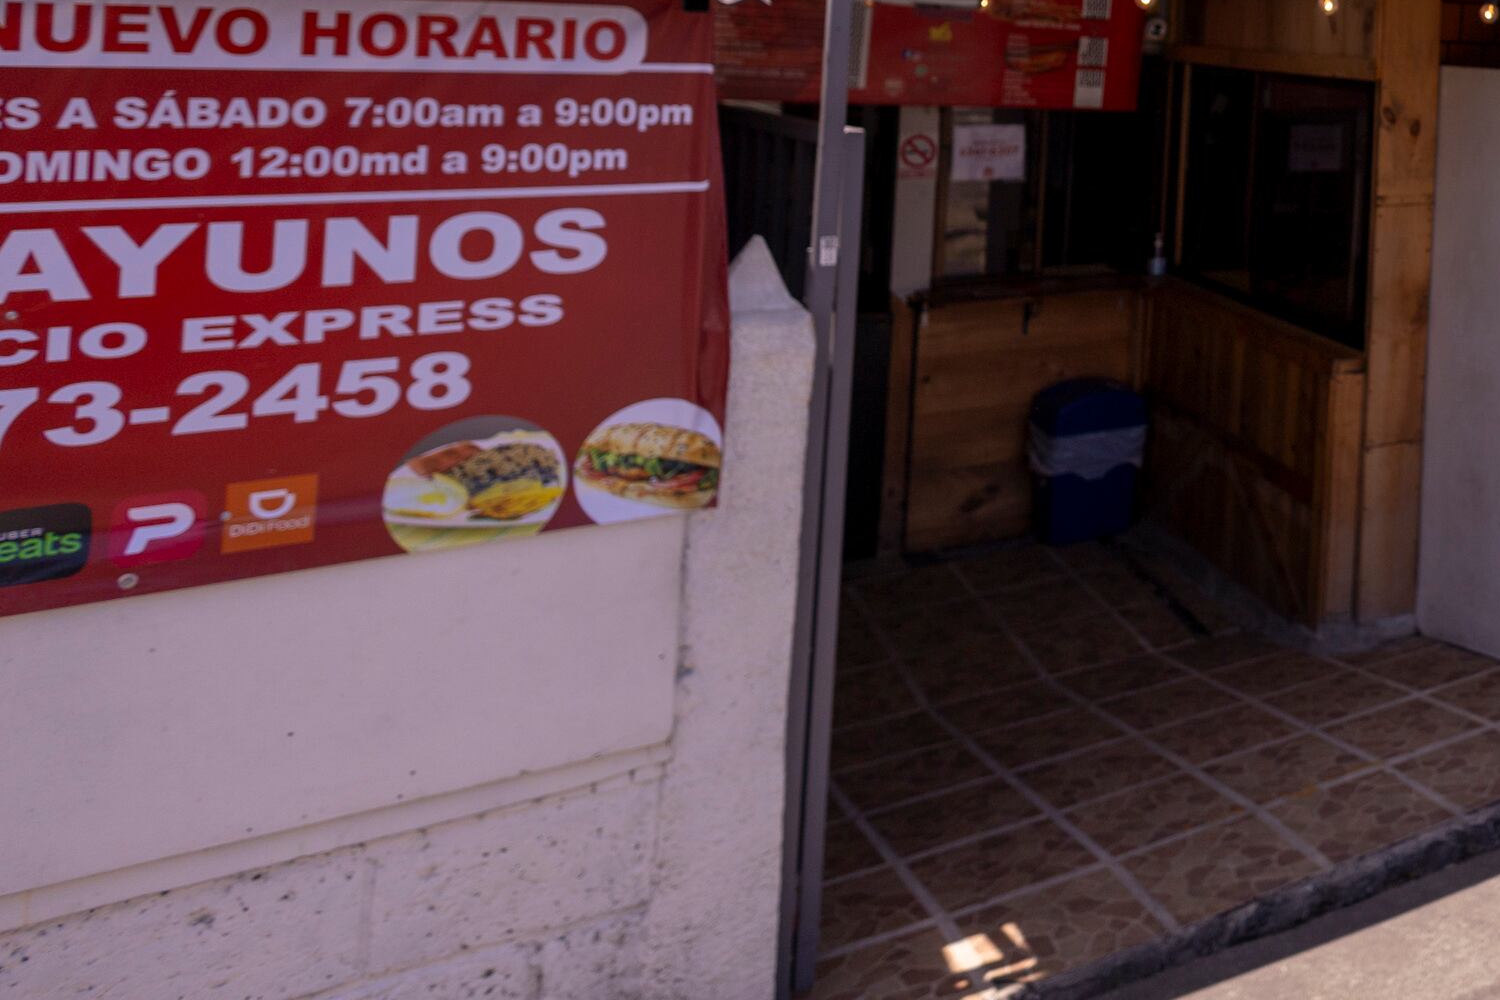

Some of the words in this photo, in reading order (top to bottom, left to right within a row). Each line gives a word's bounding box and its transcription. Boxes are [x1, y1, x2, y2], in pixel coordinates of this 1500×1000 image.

[302, 10, 628, 62] HORARIO
[56, 97, 97, 130] A
[113, 89, 326, 130] SÁBADO
[345, 98, 505, 129] 7:00am
[517, 105, 541, 127] a
[555, 98, 693, 133] 9:00pm
[230, 143, 428, 179] 12:00md
[441, 151, 467, 175] a
[481, 143, 628, 179] 9:00pm
[0, 208, 608, 305] AYUNOS
[181, 294, 564, 353] EXPRESS
